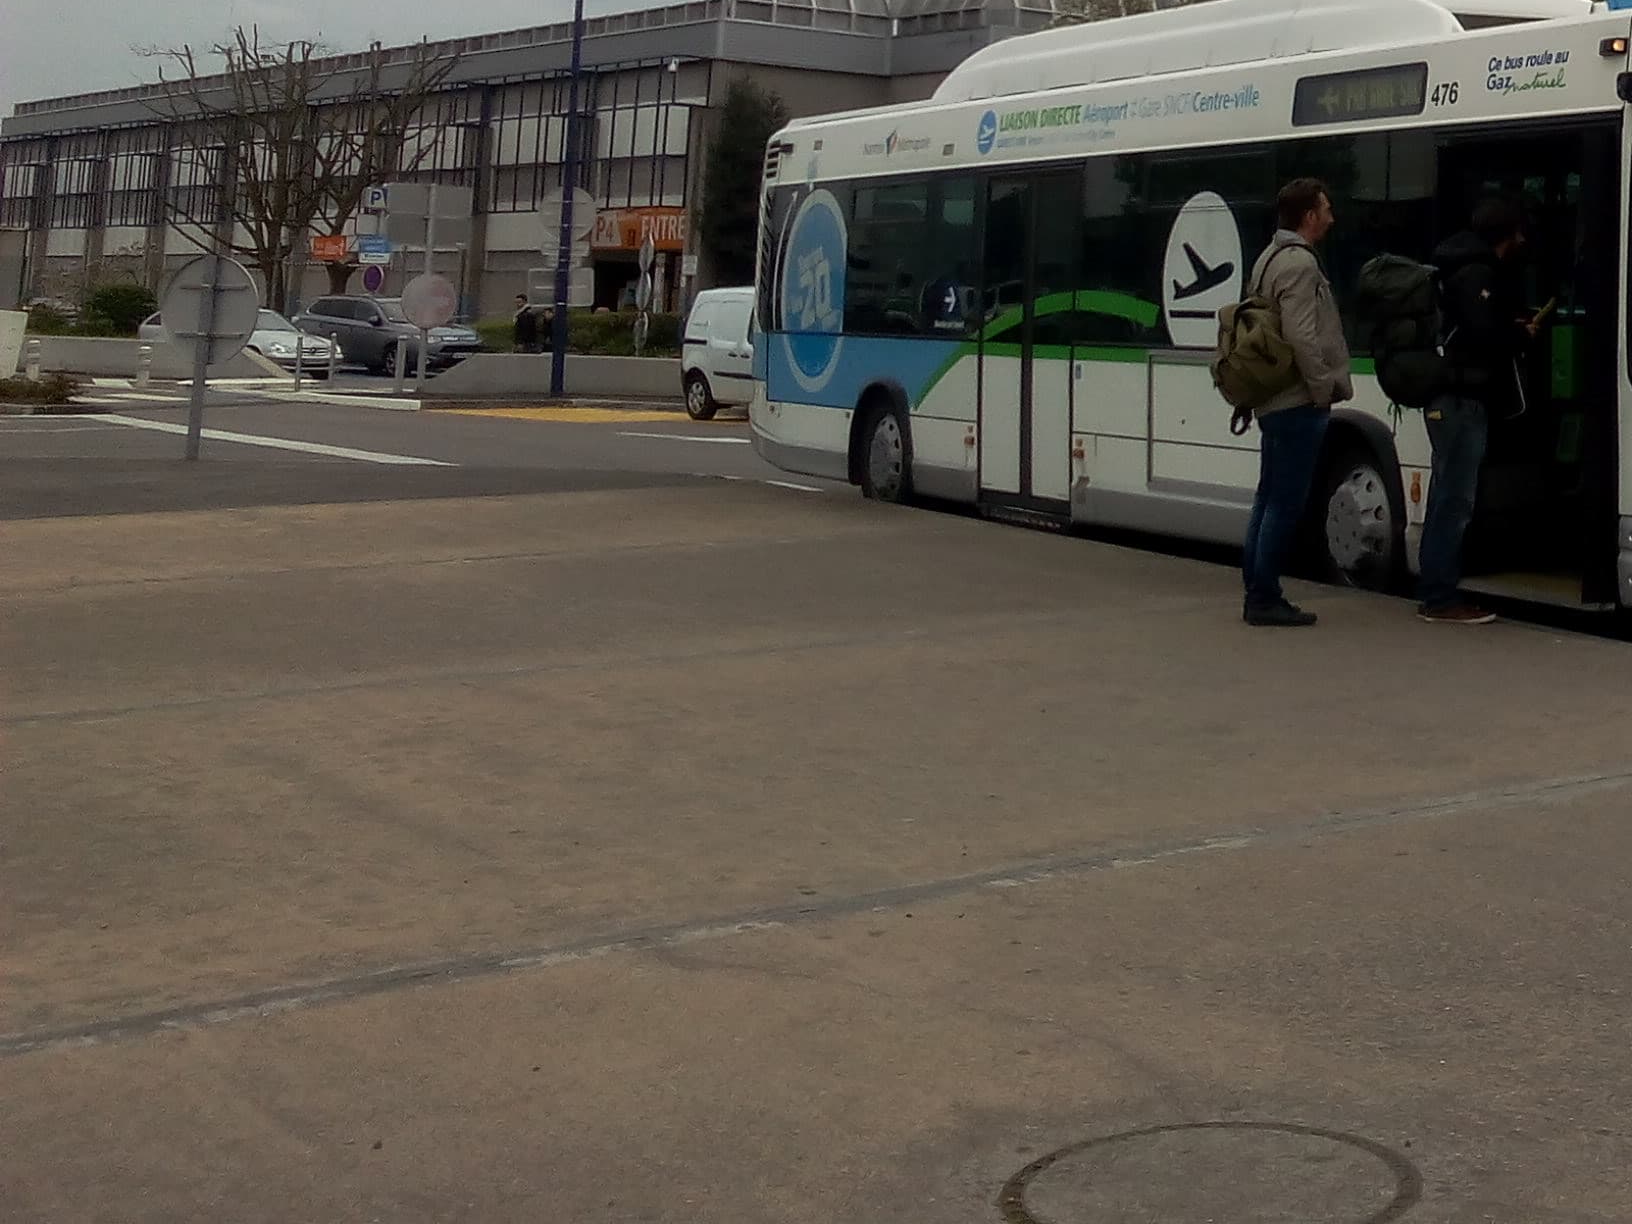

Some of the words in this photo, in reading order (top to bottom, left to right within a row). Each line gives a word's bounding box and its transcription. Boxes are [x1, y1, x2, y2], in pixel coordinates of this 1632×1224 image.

[1488, 56, 1502, 73] Ce
[1503, 53, 1524, 71] bus
[1524, 50, 1554, 69] roule
[1554, 49, 1570, 64] au
[1430, 82, 1460, 107] 476
[1486, 74, 1512, 91] Gaz
[999, 109, 1037, 132] LIAISON
[1039, 104, 1083, 128] DIRECTE
[1191, 83, 1260, 113] Centre-ville
[595, 215, 614, 244] P4
